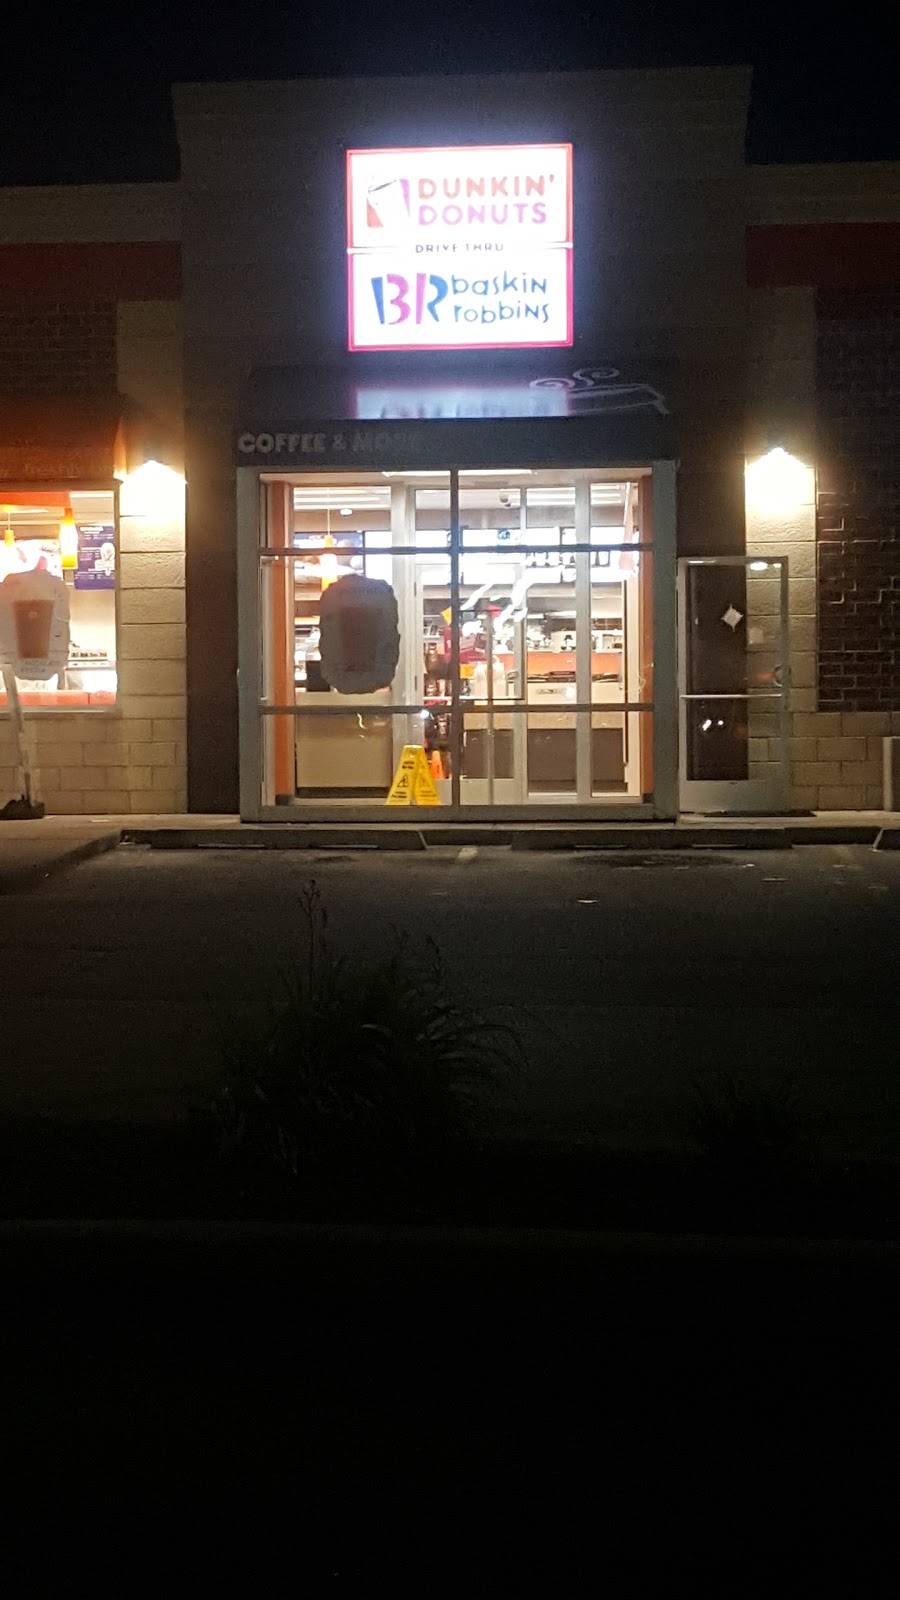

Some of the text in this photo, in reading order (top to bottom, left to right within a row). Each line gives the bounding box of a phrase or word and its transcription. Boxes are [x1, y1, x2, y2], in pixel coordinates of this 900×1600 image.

[418, 174, 555, 200] DUNKIN'
[418, 202, 547, 226] DONUTS
[415, 242, 504, 254] DRIVE THRU
[371, 273, 449, 325] BR
[237, 432, 326, 454] COFFEE
[332, 433, 346, 451] &
